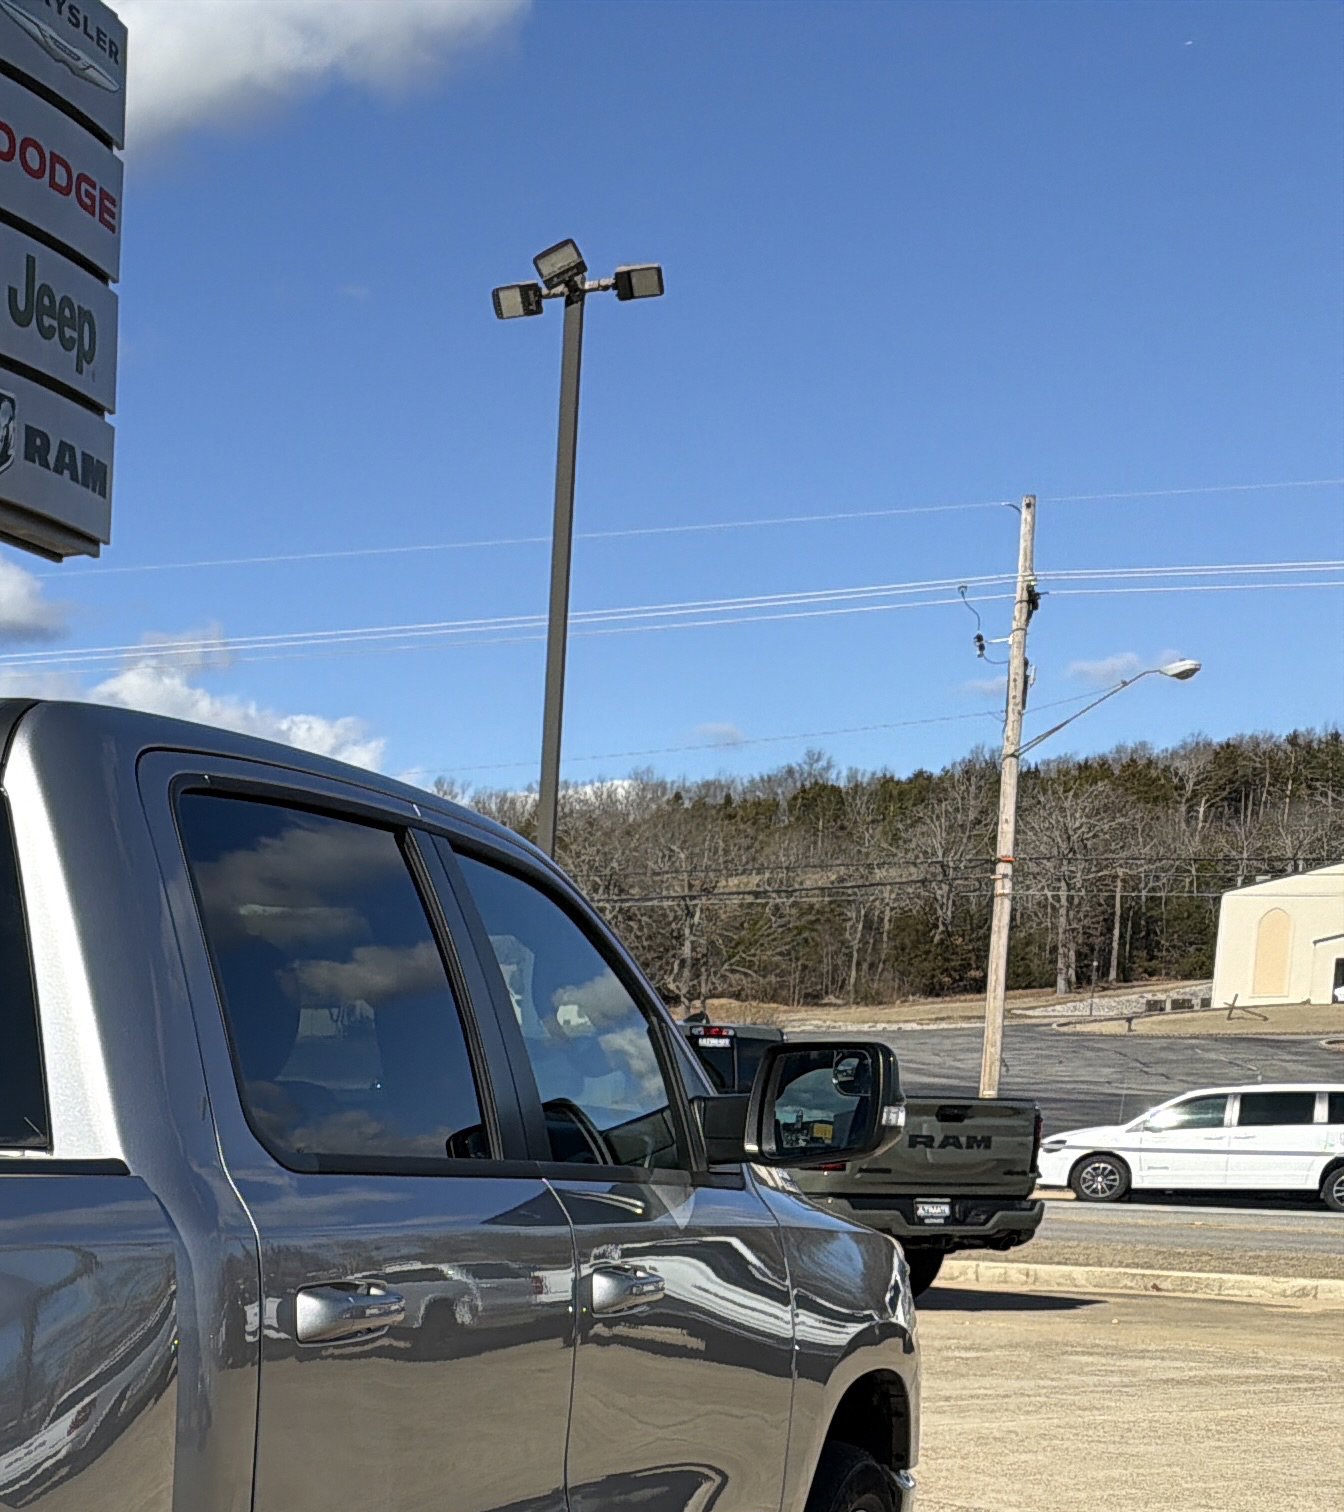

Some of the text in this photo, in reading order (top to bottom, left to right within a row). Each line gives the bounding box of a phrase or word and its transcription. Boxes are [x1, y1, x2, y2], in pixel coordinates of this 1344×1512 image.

[8, 254, 96, 373] Jeep
[24, 423, 108, 500] RAM
[908, 1135, 993, 1150] RAM
